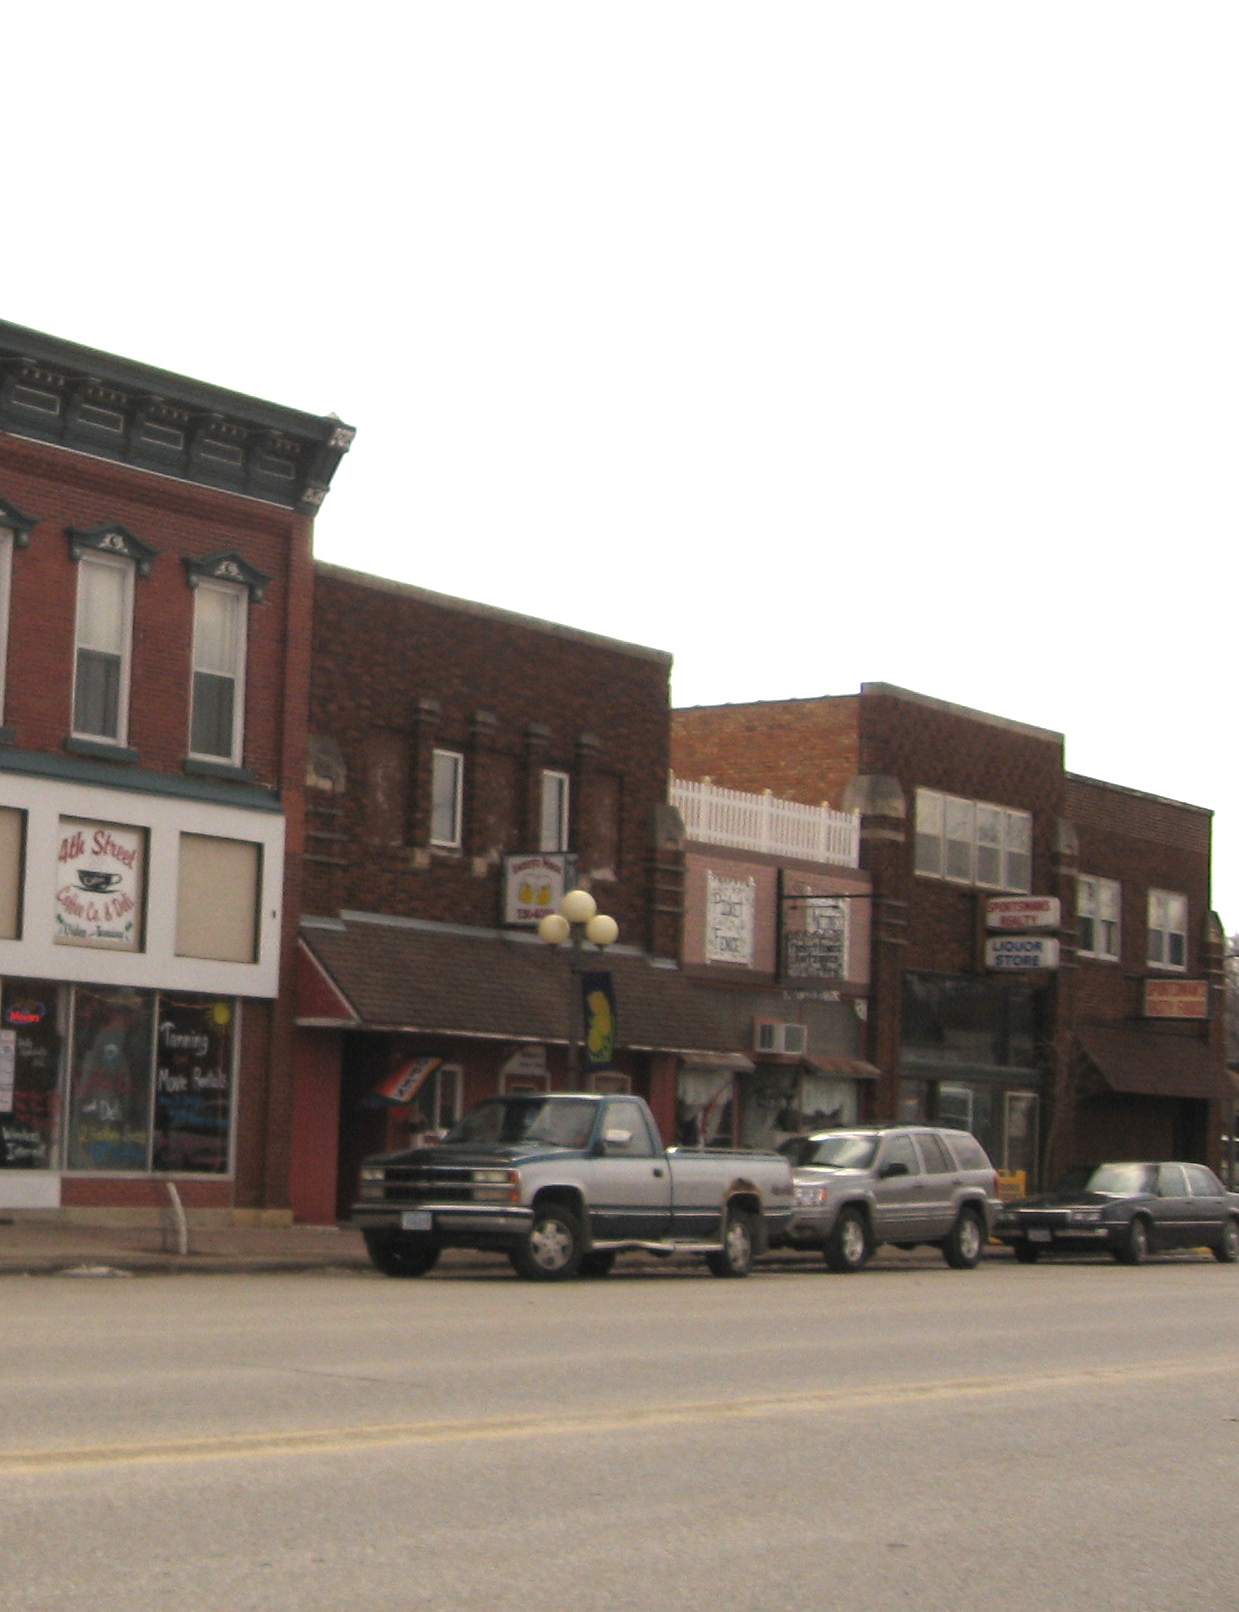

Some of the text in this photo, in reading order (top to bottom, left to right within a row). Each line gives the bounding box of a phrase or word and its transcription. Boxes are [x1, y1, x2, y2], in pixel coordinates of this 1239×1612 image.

[58, 830, 135, 869] 4th Street
[992, 941, 1043, 952] LIQUOR
[995, 954, 1040, 966] STORE
[161, 1022, 208, 1056] Tanning
